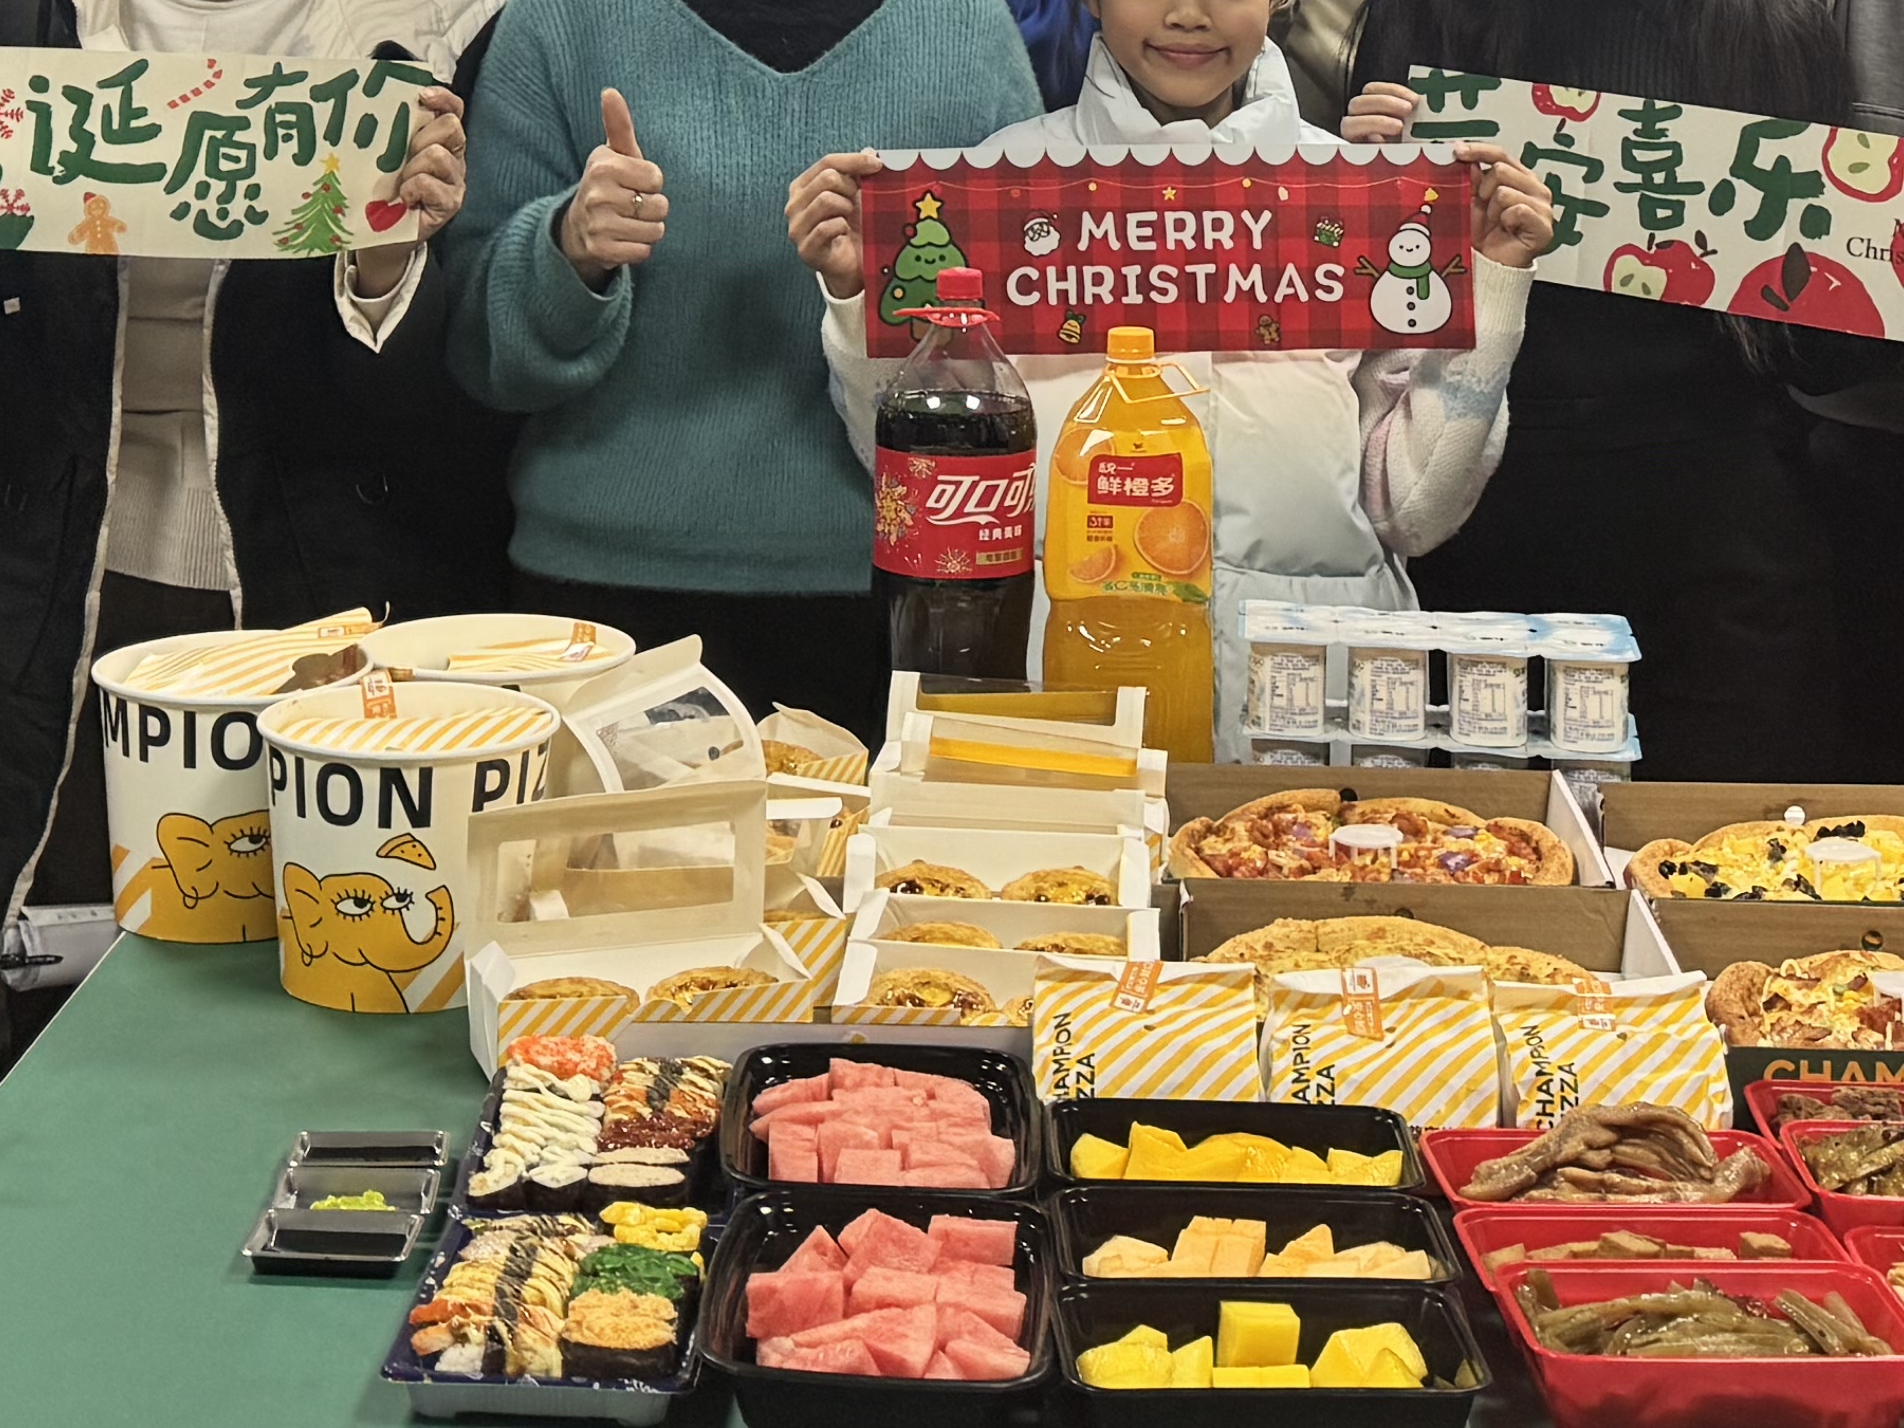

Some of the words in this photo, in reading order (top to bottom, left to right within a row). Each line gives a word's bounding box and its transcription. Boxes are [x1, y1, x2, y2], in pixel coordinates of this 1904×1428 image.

[1077, 210, 1273, 250] MERRY
[1006, 263, 1346, 305] CHRISTMAS
[1097, 475, 1175, 497] 鲜橙多
